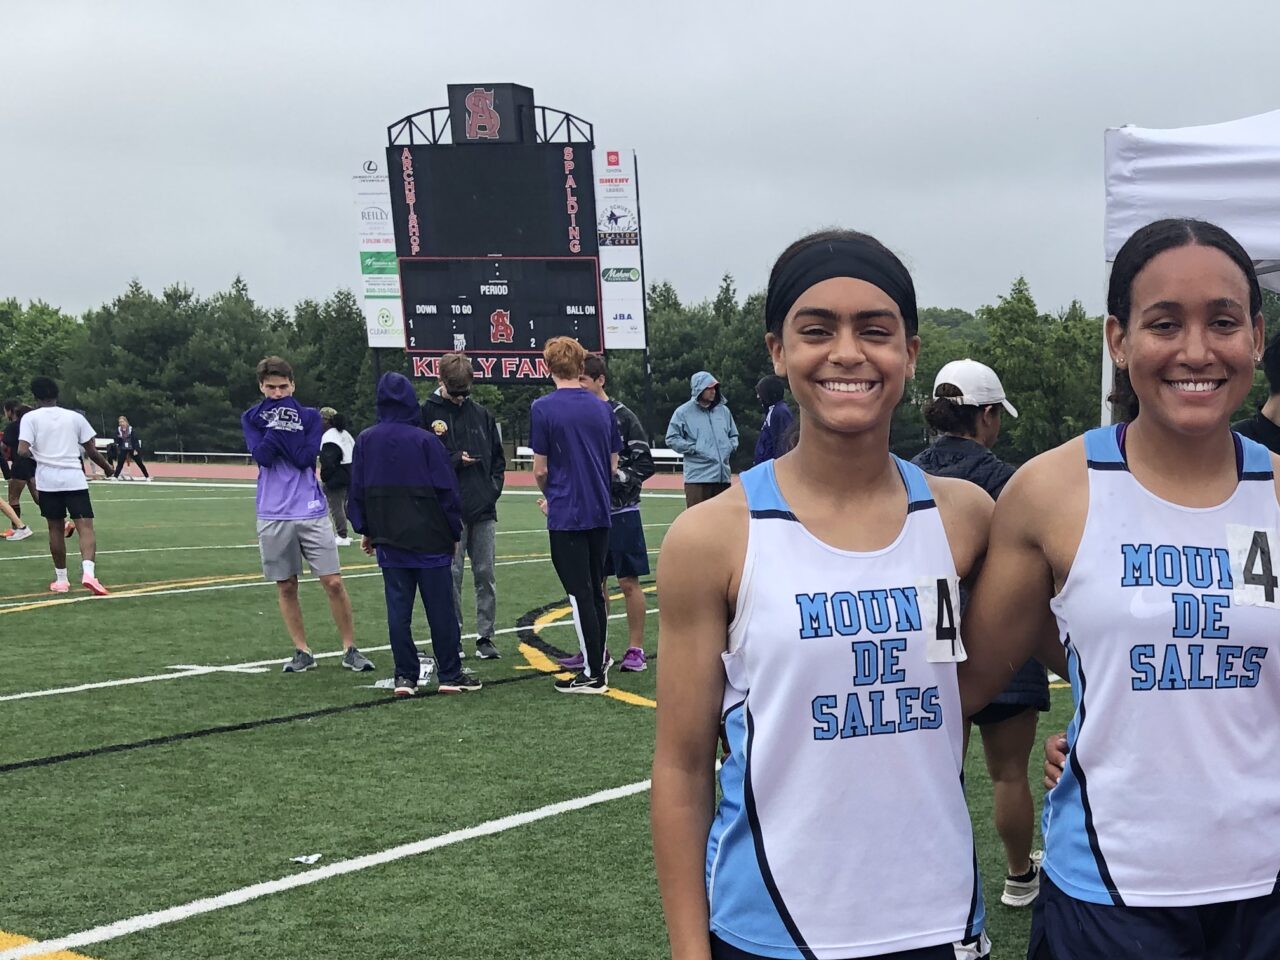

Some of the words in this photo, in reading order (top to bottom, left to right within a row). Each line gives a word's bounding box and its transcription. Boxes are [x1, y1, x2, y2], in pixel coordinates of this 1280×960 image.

[361, 211, 389, 221] REILLY
[401, 147, 420, 255] ARCHBISHOP
[564, 146, 581, 253] SPALDING
[416, 305, 437, 314] DOWN
[451, 305, 461, 314] TO
[462, 305, 472, 314] GO
[480, 285, 508, 295] PERIOD
[566, 305, 584, 315] BALL
[585, 305, 596, 315] ON
[409, 319, 414, 329] 1
[410, 336, 416, 346] 2
[529, 320, 534, 330] 1
[530, 338, 536, 348] 2
[1121, 543, 1233, 589] MOUN
[1242, 531, 1279, 604] 4
[795, 585, 922, 639] MOUN
[935, 578, 957, 656] 4
[1172, 592, 1230, 639] DE
[852, 638, 908, 686] DE
[1129, 643, 1268, 691] SALES
[812, 685, 943, 741] SALES
